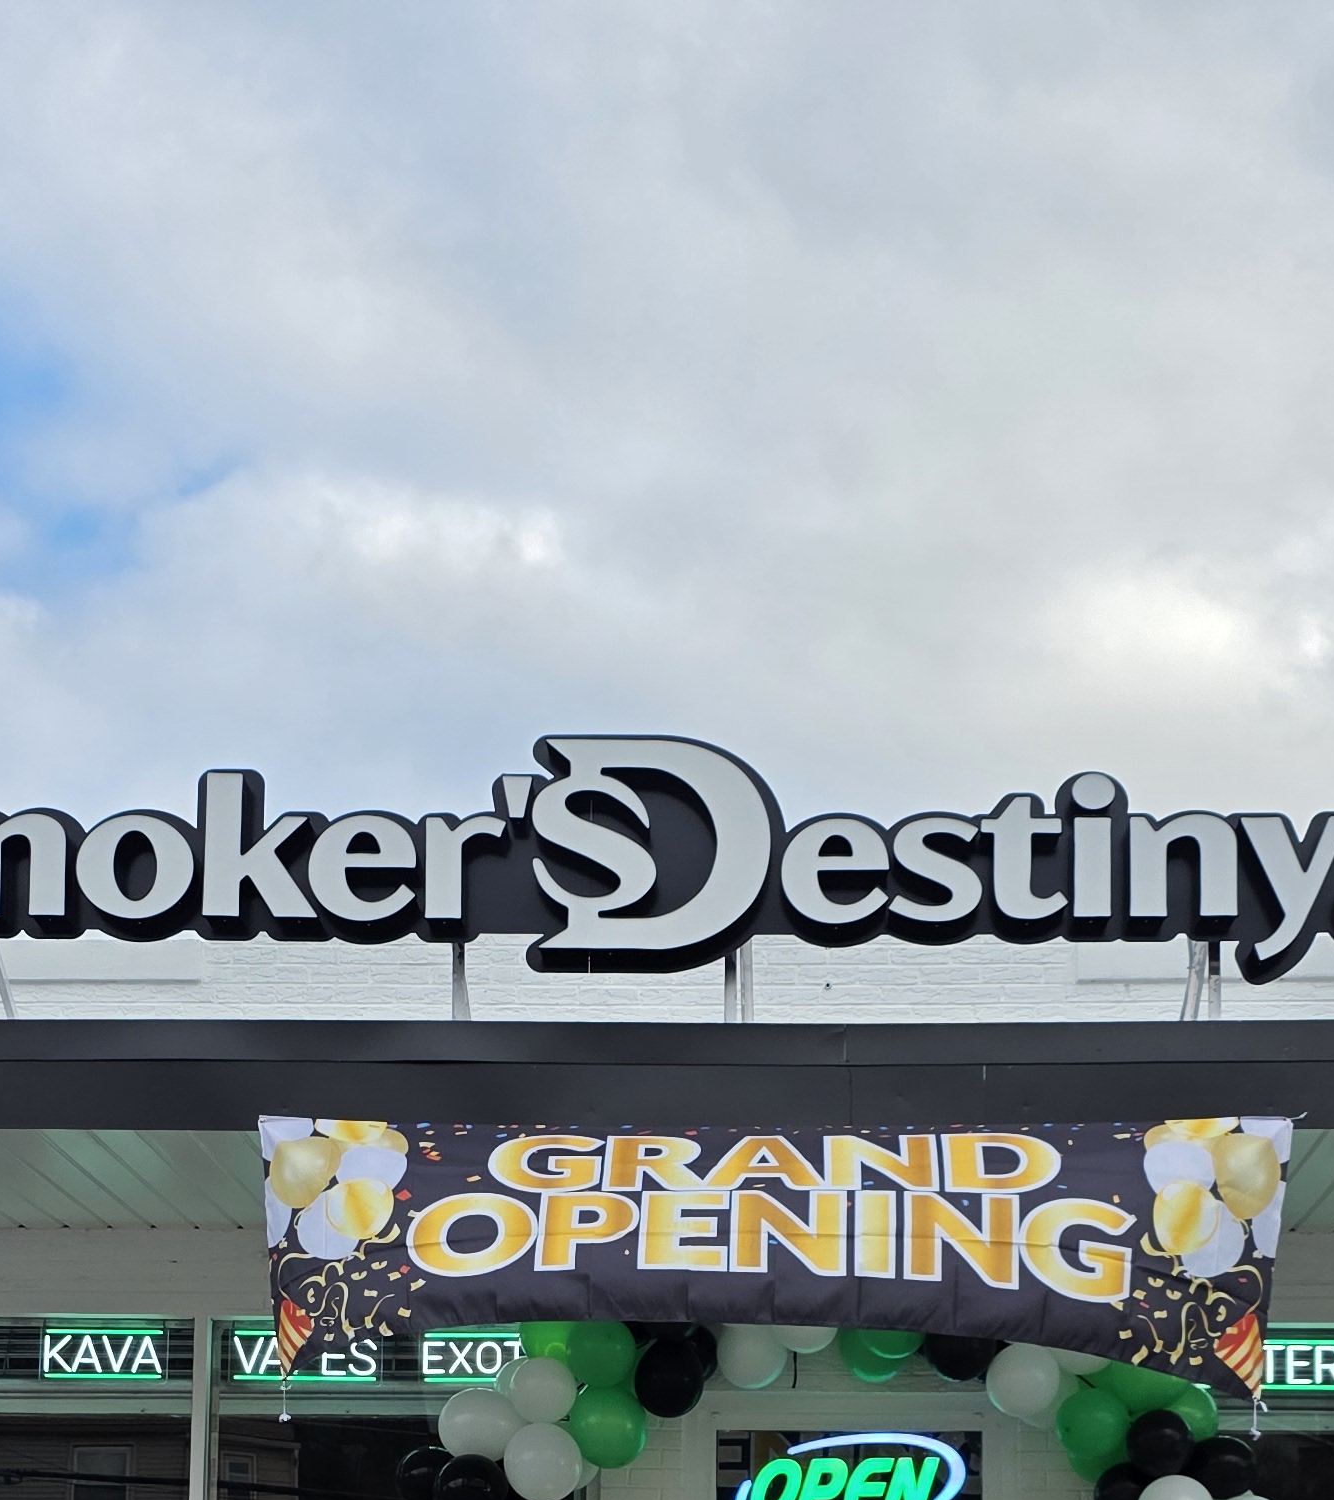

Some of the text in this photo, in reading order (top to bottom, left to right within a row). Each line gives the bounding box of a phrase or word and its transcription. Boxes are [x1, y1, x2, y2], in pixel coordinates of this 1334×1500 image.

[488, 1131, 1063, 1193] GRAND
[405, 1190, 1136, 1303] OPENING
[42, 1334, 163, 1375] KAVA
[233, 1335, 379, 1377] VAES
[422, 1340, 522, 1375] EXOT
